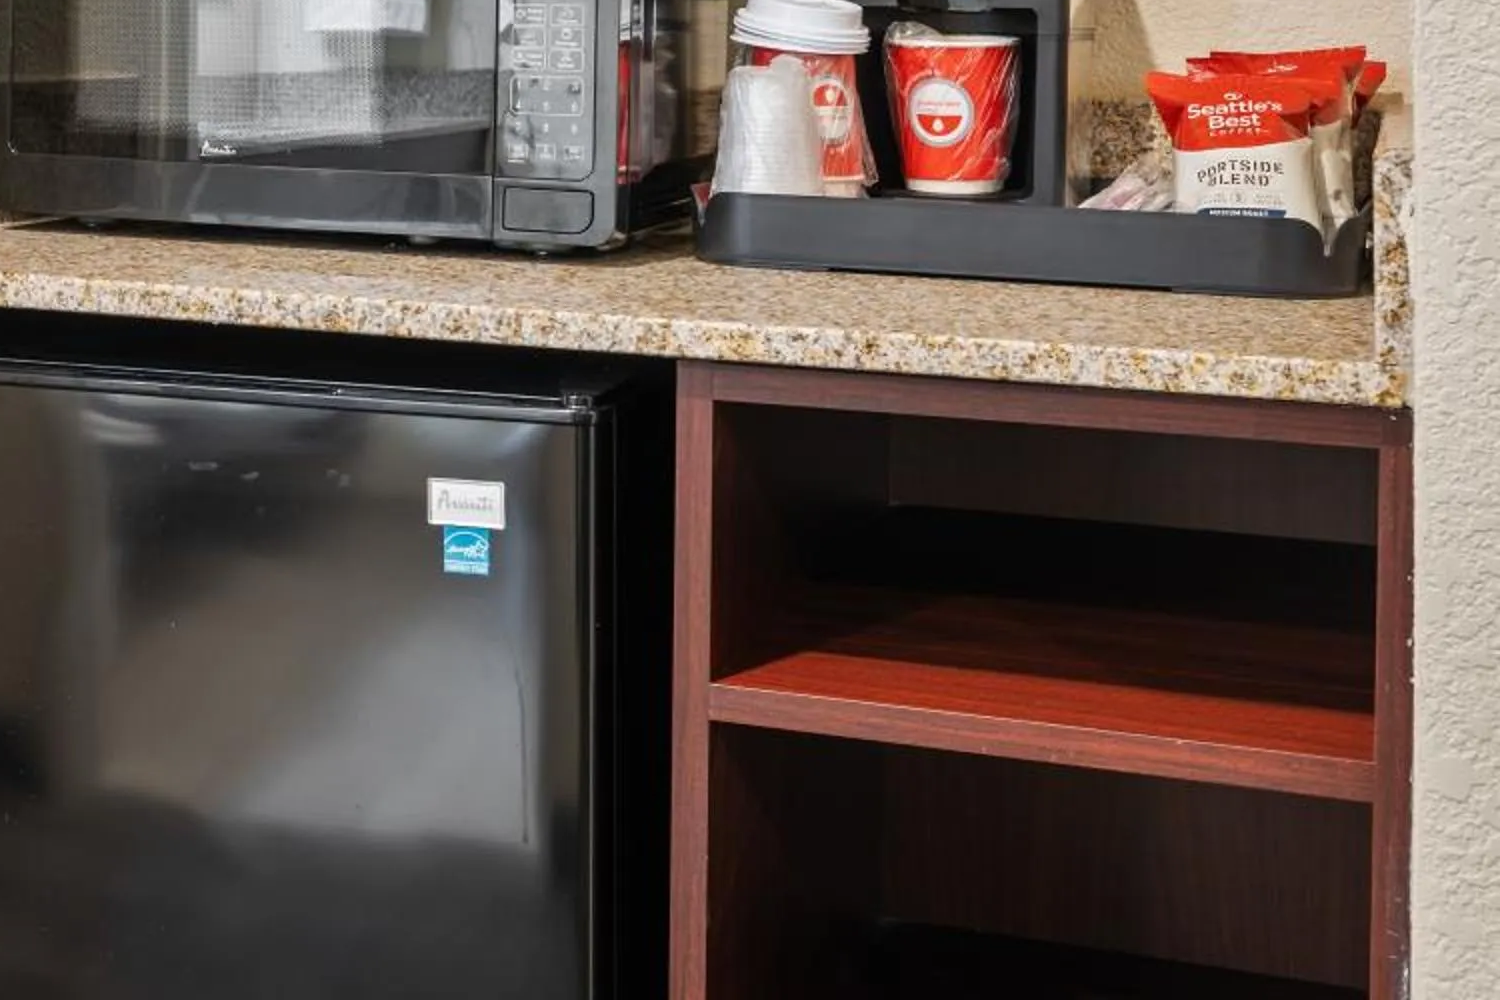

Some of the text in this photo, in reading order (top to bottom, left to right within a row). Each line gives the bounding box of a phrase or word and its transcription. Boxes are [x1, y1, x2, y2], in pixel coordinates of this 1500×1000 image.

[1187, 99, 1283, 119] Seattle's
[1209, 113, 1261, 129] Best
[1197, 159, 1285, 183] PORTSIDE
